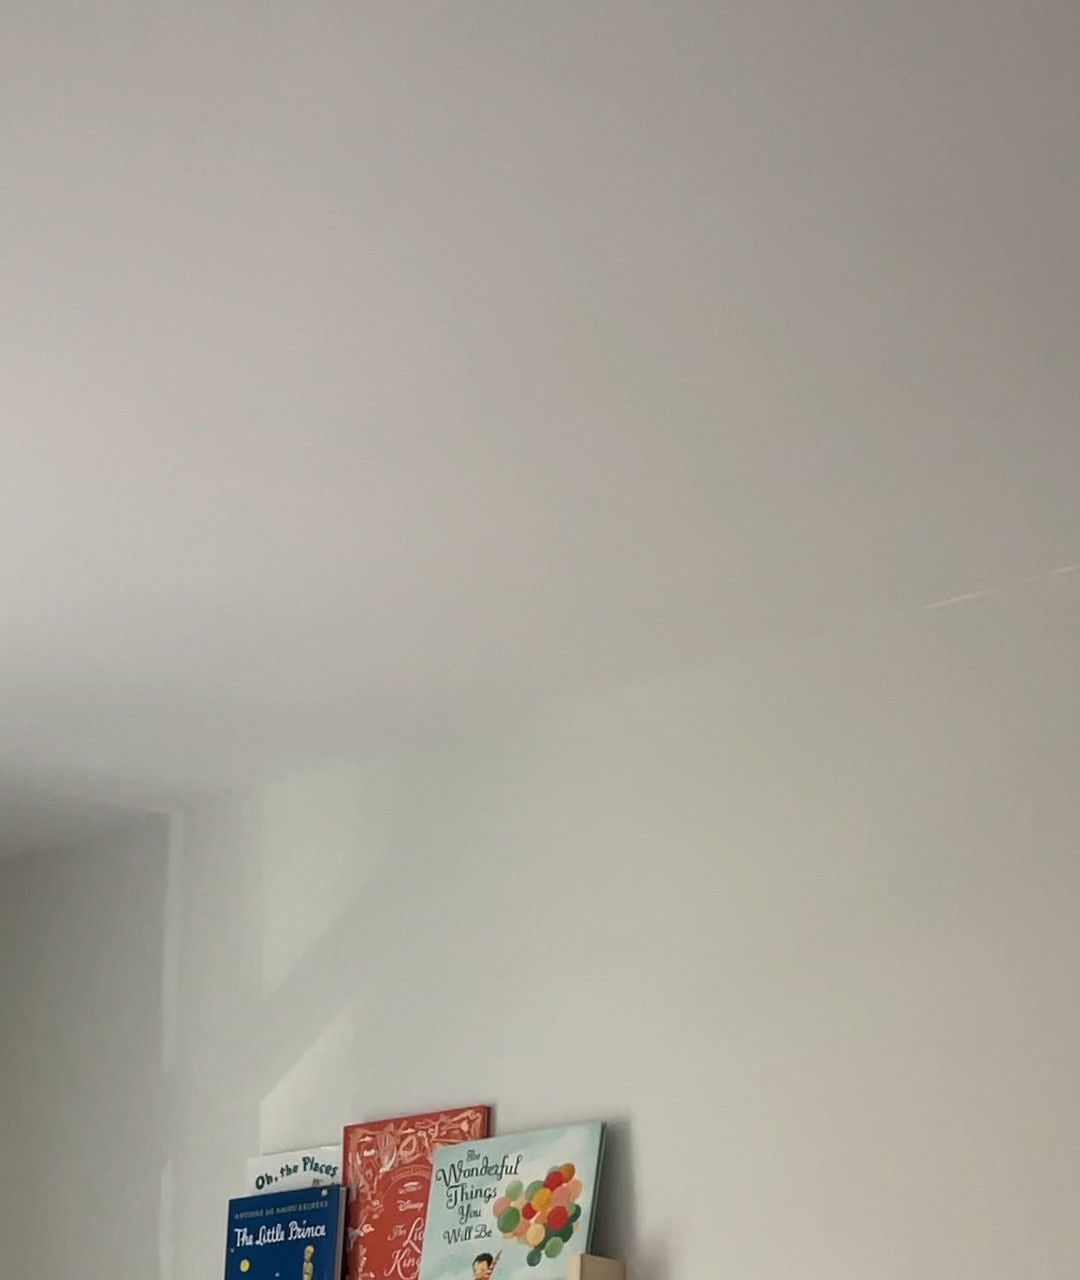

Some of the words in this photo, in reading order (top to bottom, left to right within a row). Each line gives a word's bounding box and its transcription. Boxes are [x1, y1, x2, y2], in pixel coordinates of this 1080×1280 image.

[280, 1164, 299, 1177] the
[302, 1156, 338, 1177] Places
[435, 1154, 523, 1187] Wonderful
[446, 1183, 497, 1209] Things
[458, 1203, 481, 1225] You
[233, 1227, 254, 1247] The
[255, 1223, 285, 1246] Little
[288, 1220, 326, 1241] Prince
[443, 1226, 473, 1244] Will
[474, 1224, 492, 1239] Be
